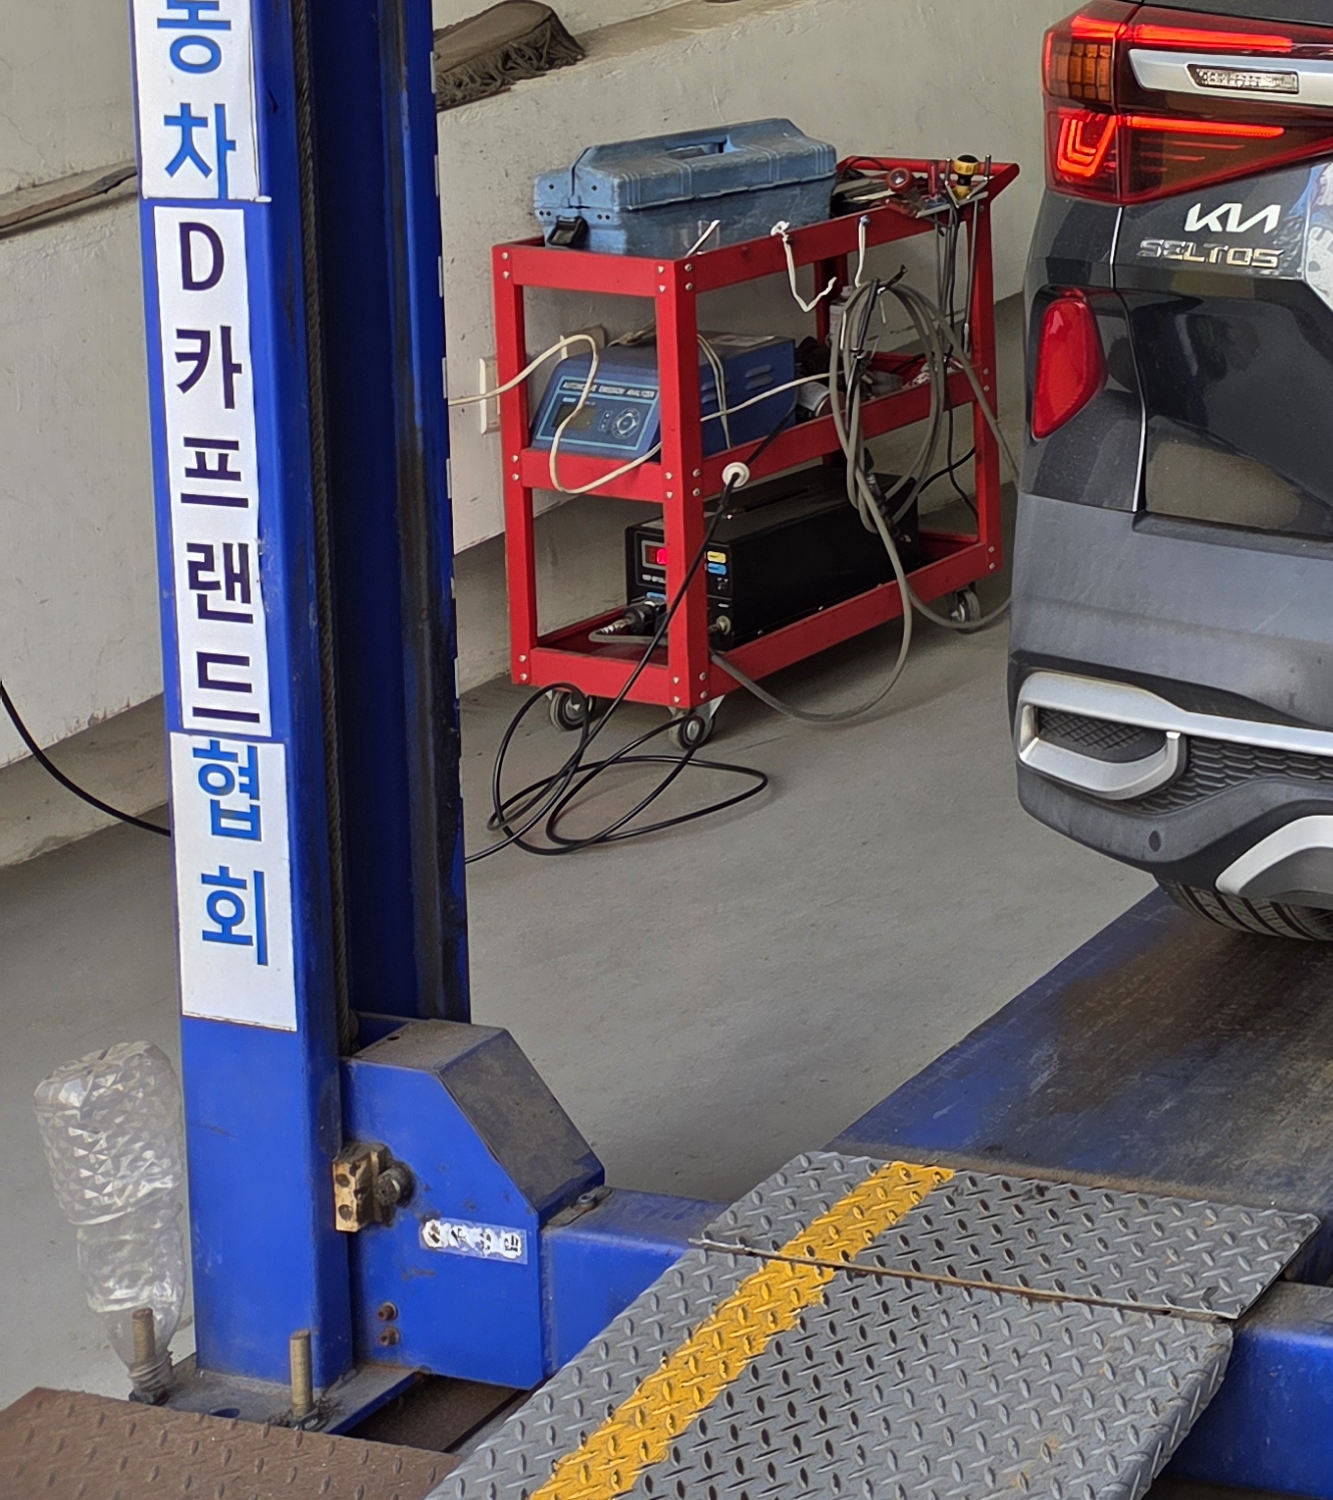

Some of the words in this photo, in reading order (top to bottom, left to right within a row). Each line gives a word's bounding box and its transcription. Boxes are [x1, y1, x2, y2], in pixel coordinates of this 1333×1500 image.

[1184, 203, 1281, 234] KIA
[1137, 237, 1284, 268] SELTOS
[192, 737, 269, 966] 협회
